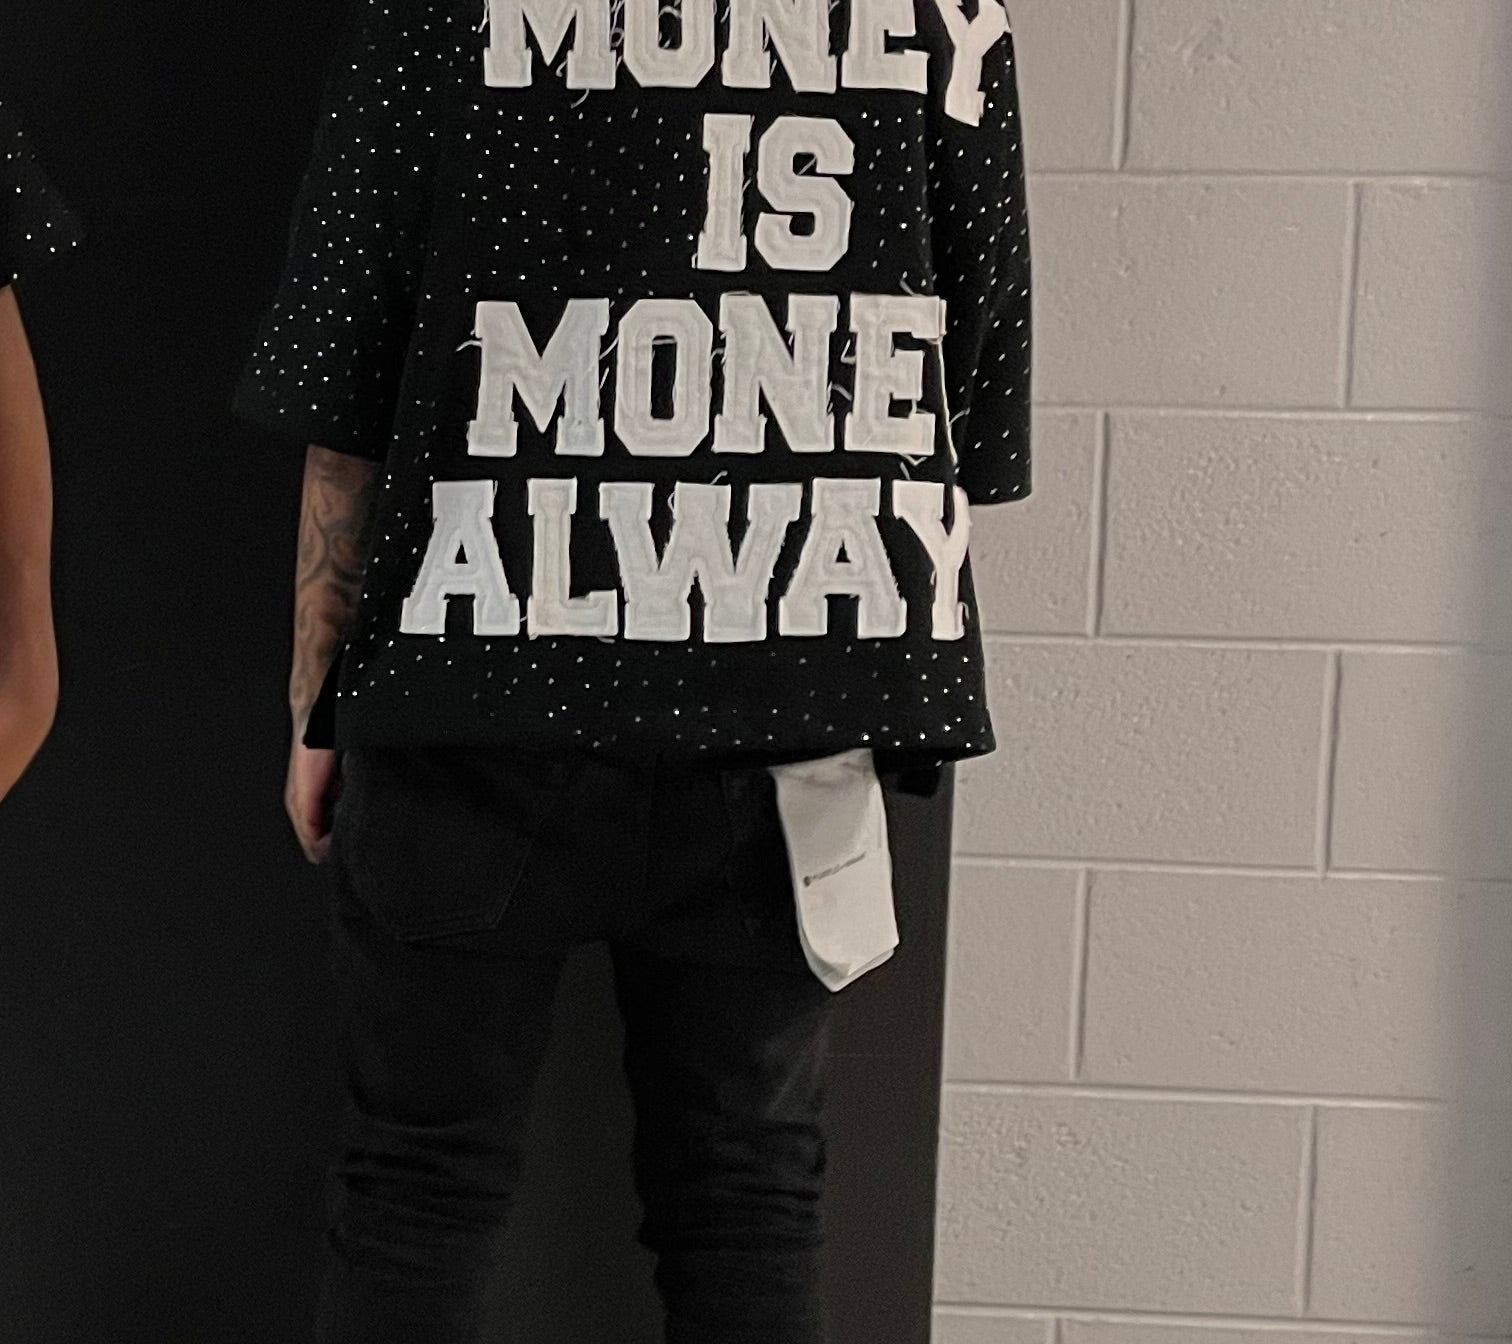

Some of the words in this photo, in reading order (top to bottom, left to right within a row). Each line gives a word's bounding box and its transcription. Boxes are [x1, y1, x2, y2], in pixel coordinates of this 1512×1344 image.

[697, 113, 856, 272] IS
[468, 293, 947, 458] MONE
[400, 476, 971, 643] ALWAY
